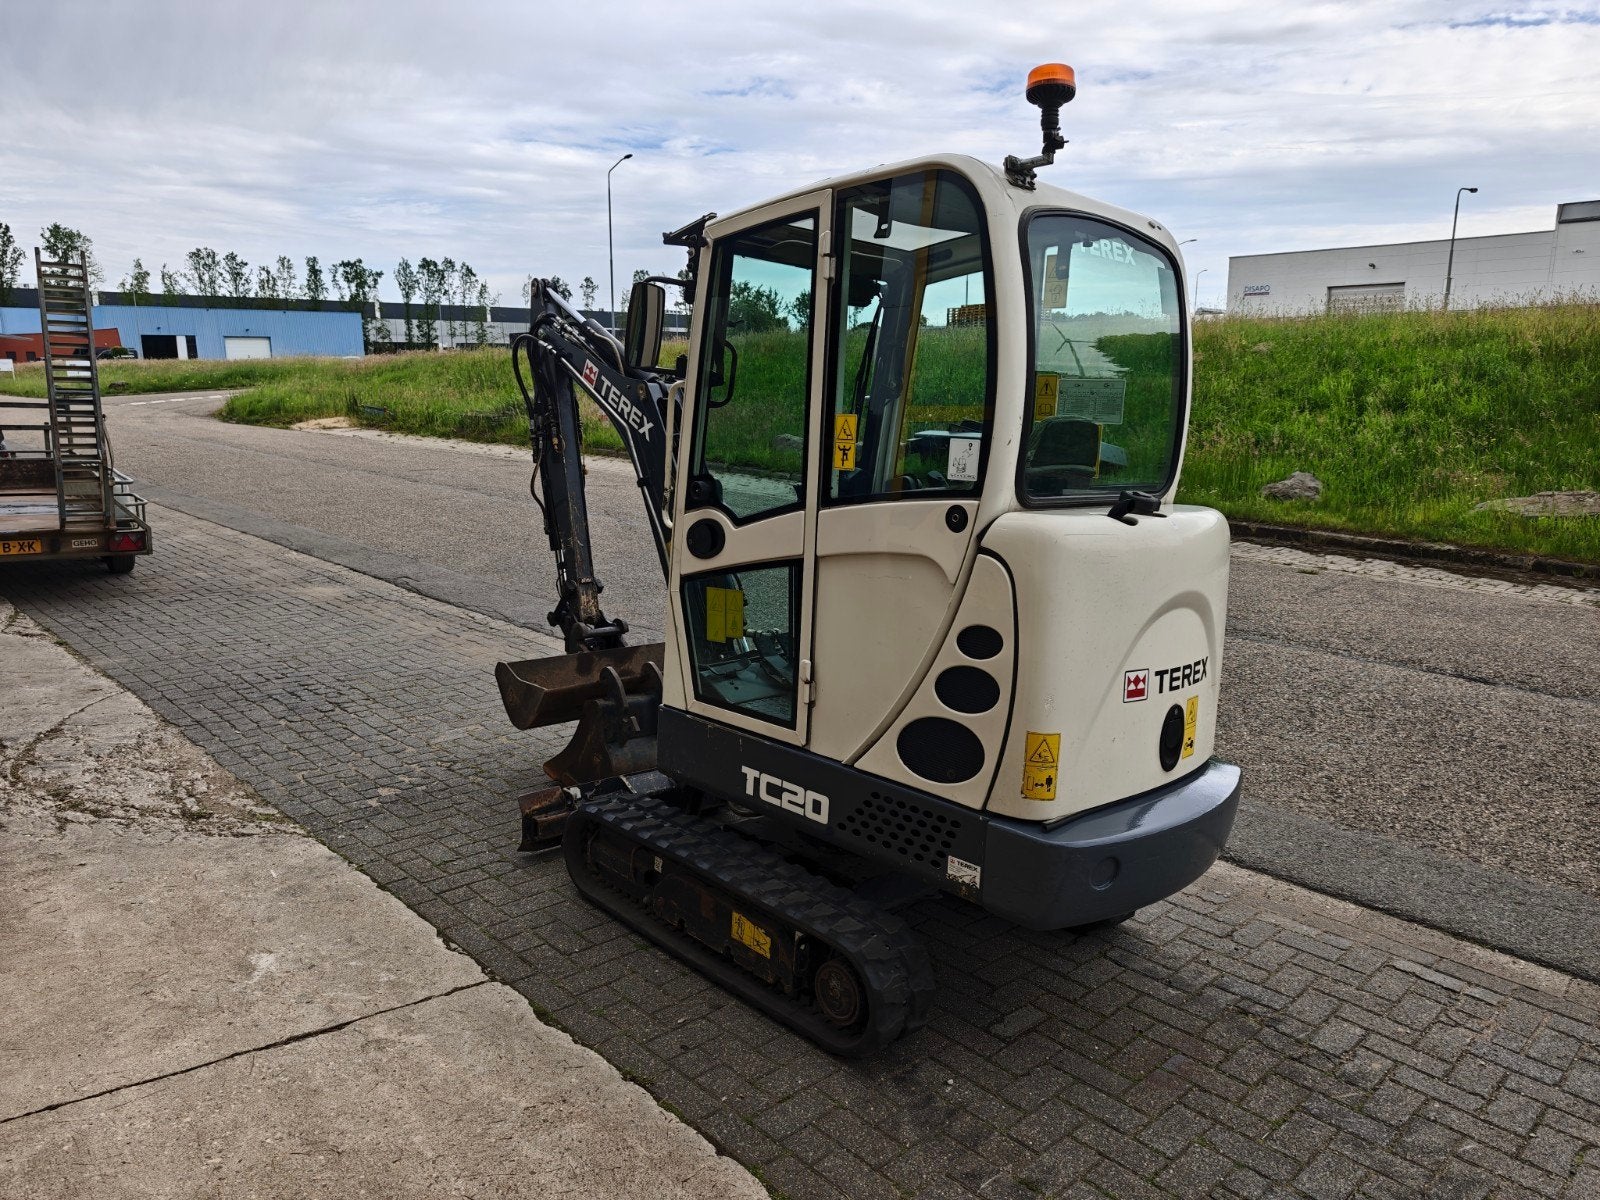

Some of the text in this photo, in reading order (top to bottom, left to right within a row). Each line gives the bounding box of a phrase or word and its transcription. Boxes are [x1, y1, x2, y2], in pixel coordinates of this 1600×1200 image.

[1075, 231, 1136, 266] TEREX
[601, 375, 654, 442] TEREX
[1155, 656, 1208, 694] TEREX
[741, 765, 830, 825] TC20
